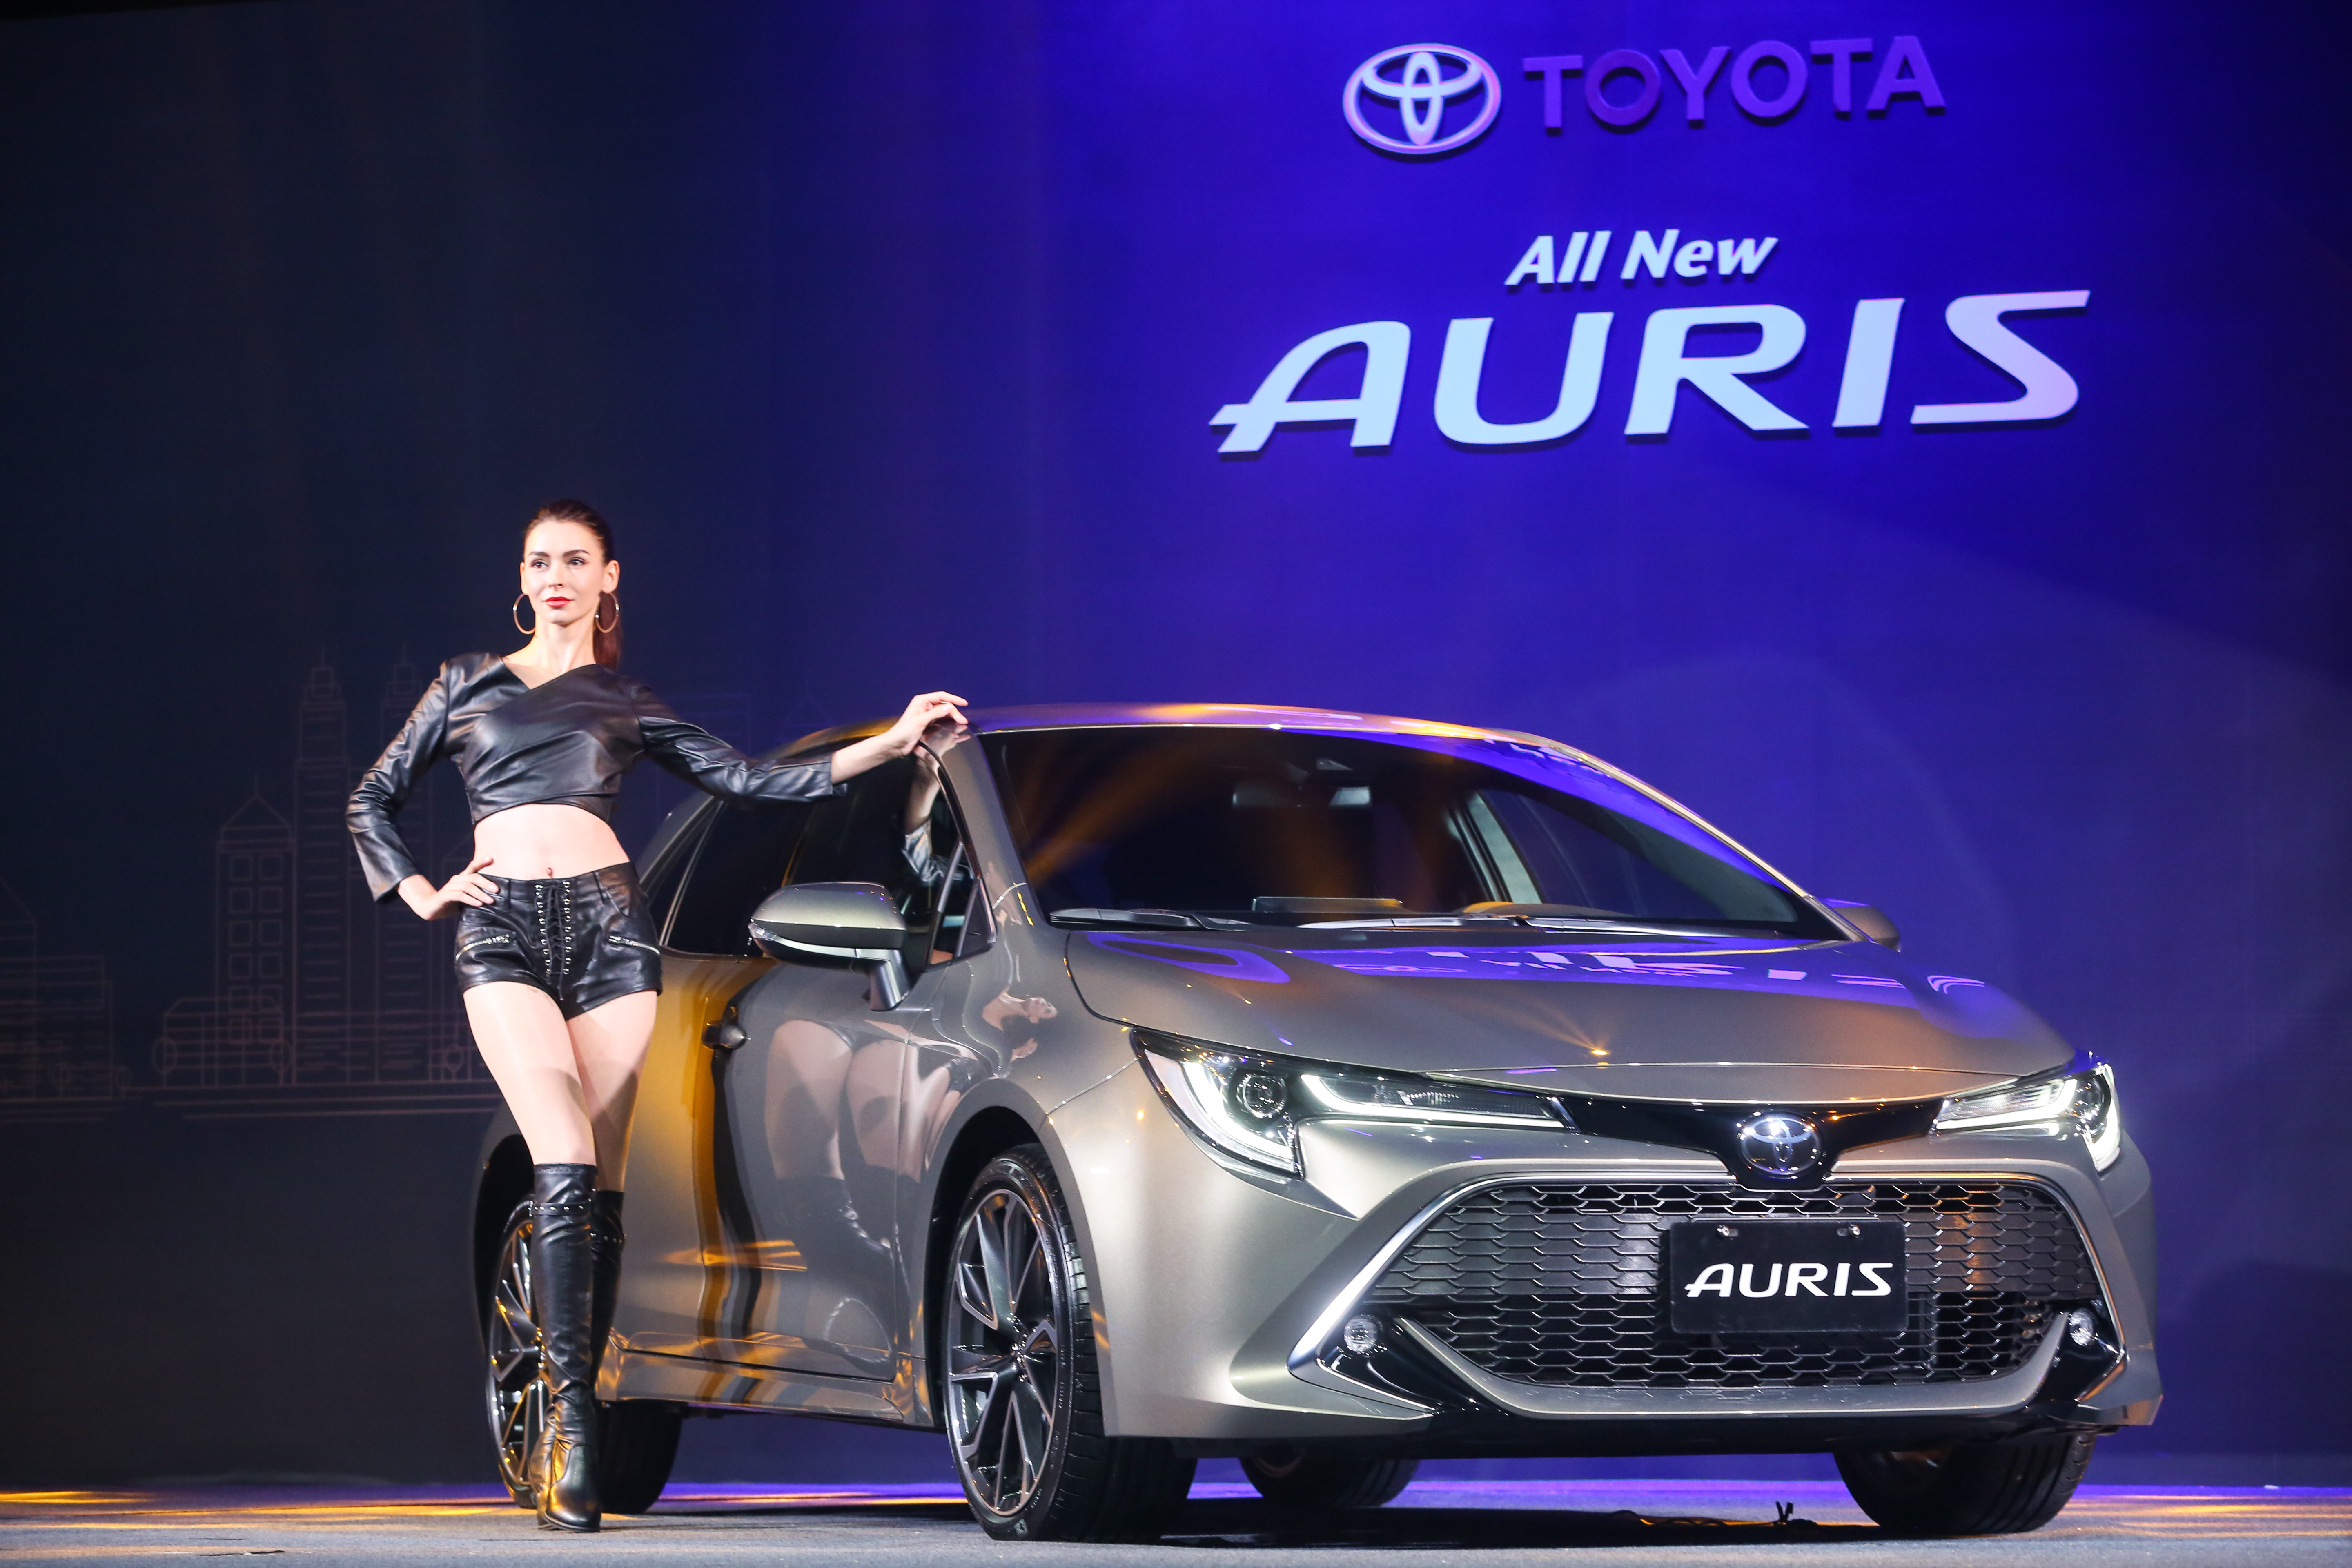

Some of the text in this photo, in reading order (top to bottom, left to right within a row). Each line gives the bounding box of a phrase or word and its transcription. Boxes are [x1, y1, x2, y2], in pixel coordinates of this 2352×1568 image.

[1523, 36, 1944, 127] TOYOTA
[1504, 229, 1778, 285] All New
[1209, 291, 2089, 452] AURIS
[1684, 1263, 1893, 1297] AURIS
